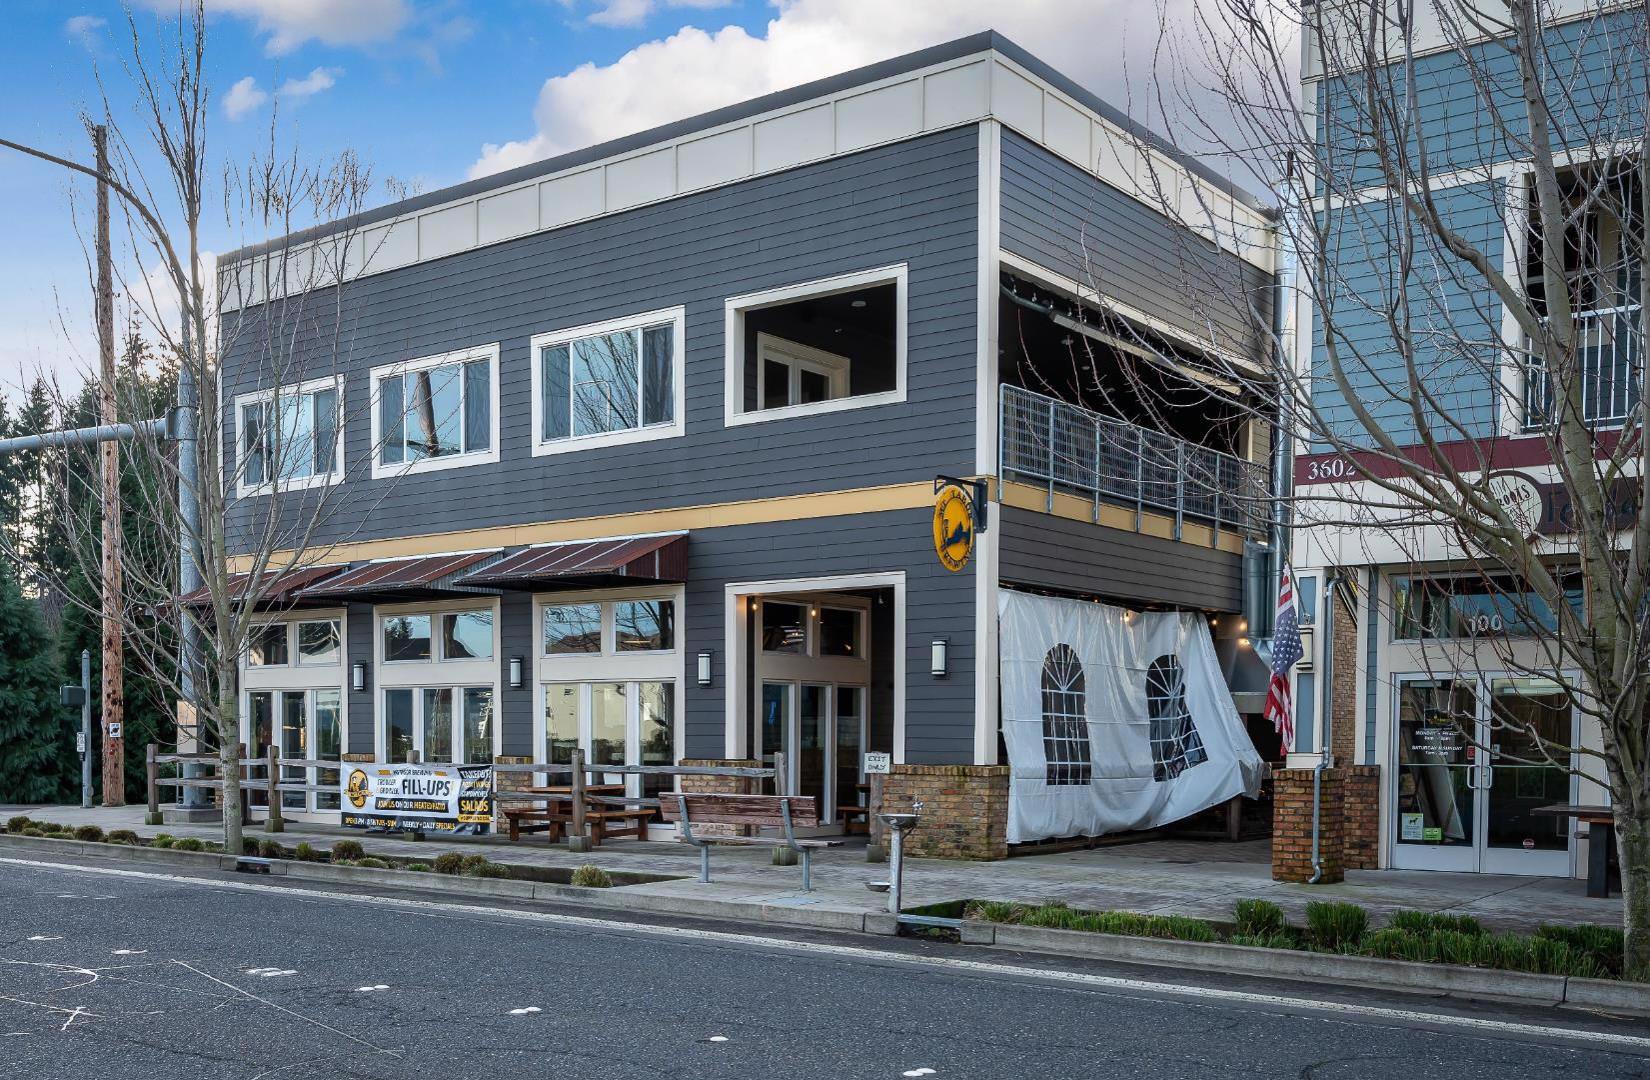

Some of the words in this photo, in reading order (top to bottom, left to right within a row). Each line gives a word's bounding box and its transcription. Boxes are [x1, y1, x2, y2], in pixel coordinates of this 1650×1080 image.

[1308, 459, 1356, 480] 3602
[1469, 614, 1502, 631] 100
[402, 779, 450, 796] FILL-UPS
[414, 801, 432, 809] HEATED
[461, 800, 489, 811] SALADS
